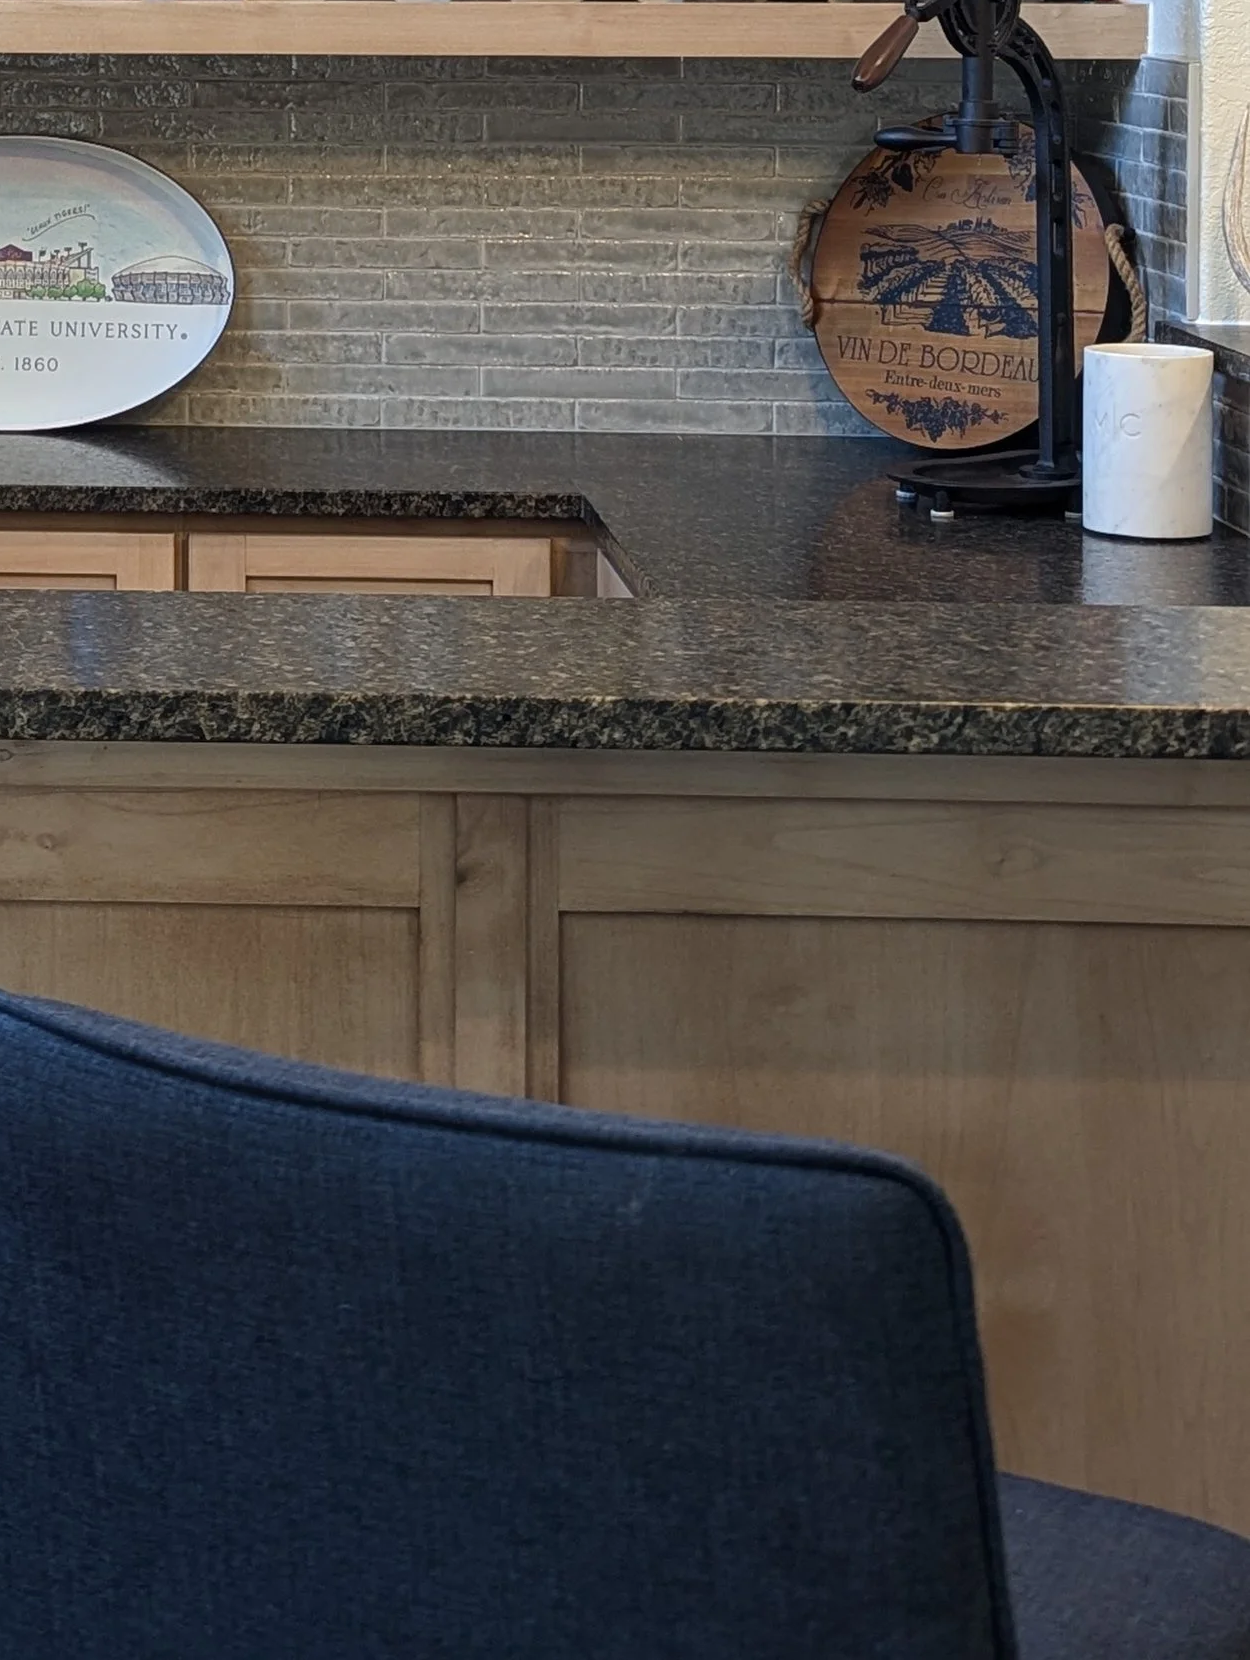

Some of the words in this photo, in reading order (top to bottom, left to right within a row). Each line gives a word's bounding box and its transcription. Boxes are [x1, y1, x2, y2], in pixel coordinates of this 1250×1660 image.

[14, 356, 60, 373] 1860
[837, 334, 873, 363] VIN
[877, 339, 912, 368] DE
[918, 343, 1040, 384] BORDEAU
[883, 369, 1003, 399] Entre-deux-mers
